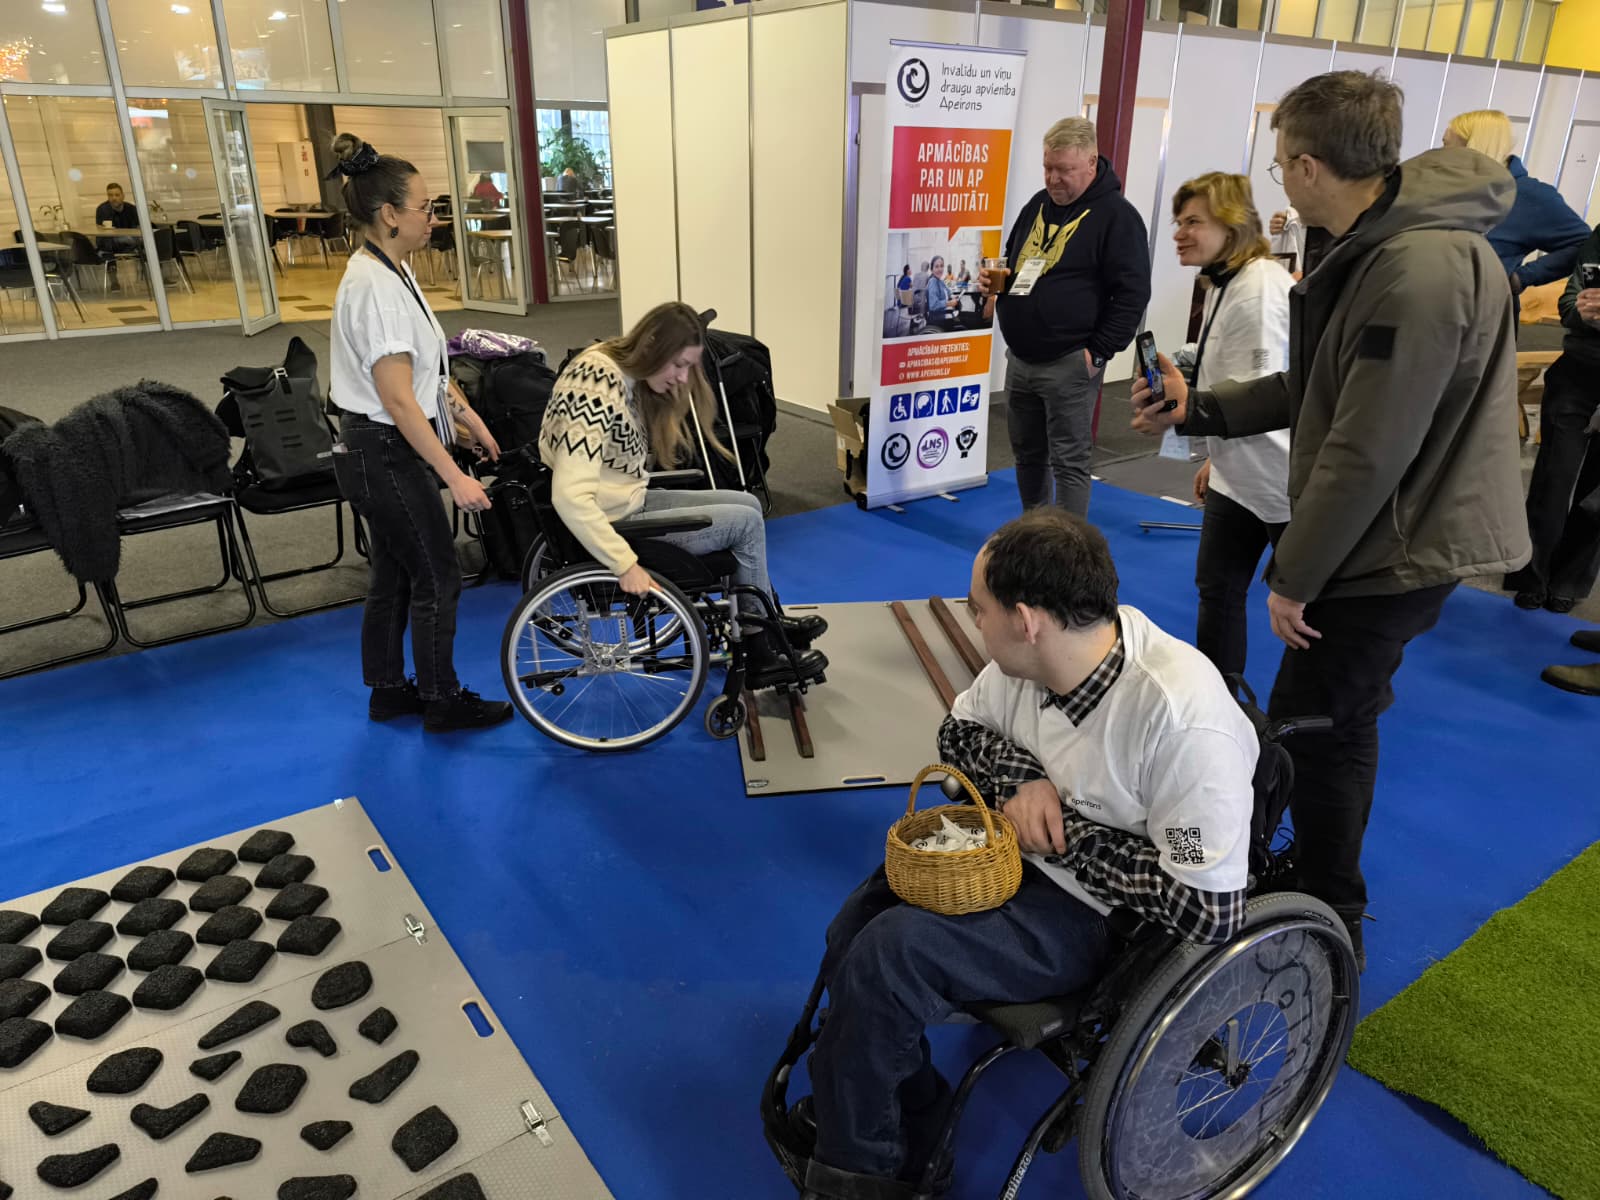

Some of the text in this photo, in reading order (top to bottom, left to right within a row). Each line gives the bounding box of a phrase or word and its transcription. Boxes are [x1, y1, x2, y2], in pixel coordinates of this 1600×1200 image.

[980, 68, 991, 79] un
[940, 79, 1016, 97] draugu apvienība
[917, 140, 989, 163] APMĀCĪBAS
[920, 168, 984, 188] PAR UN AP
[911, 190, 989, 213] INVALIDITĀTI
